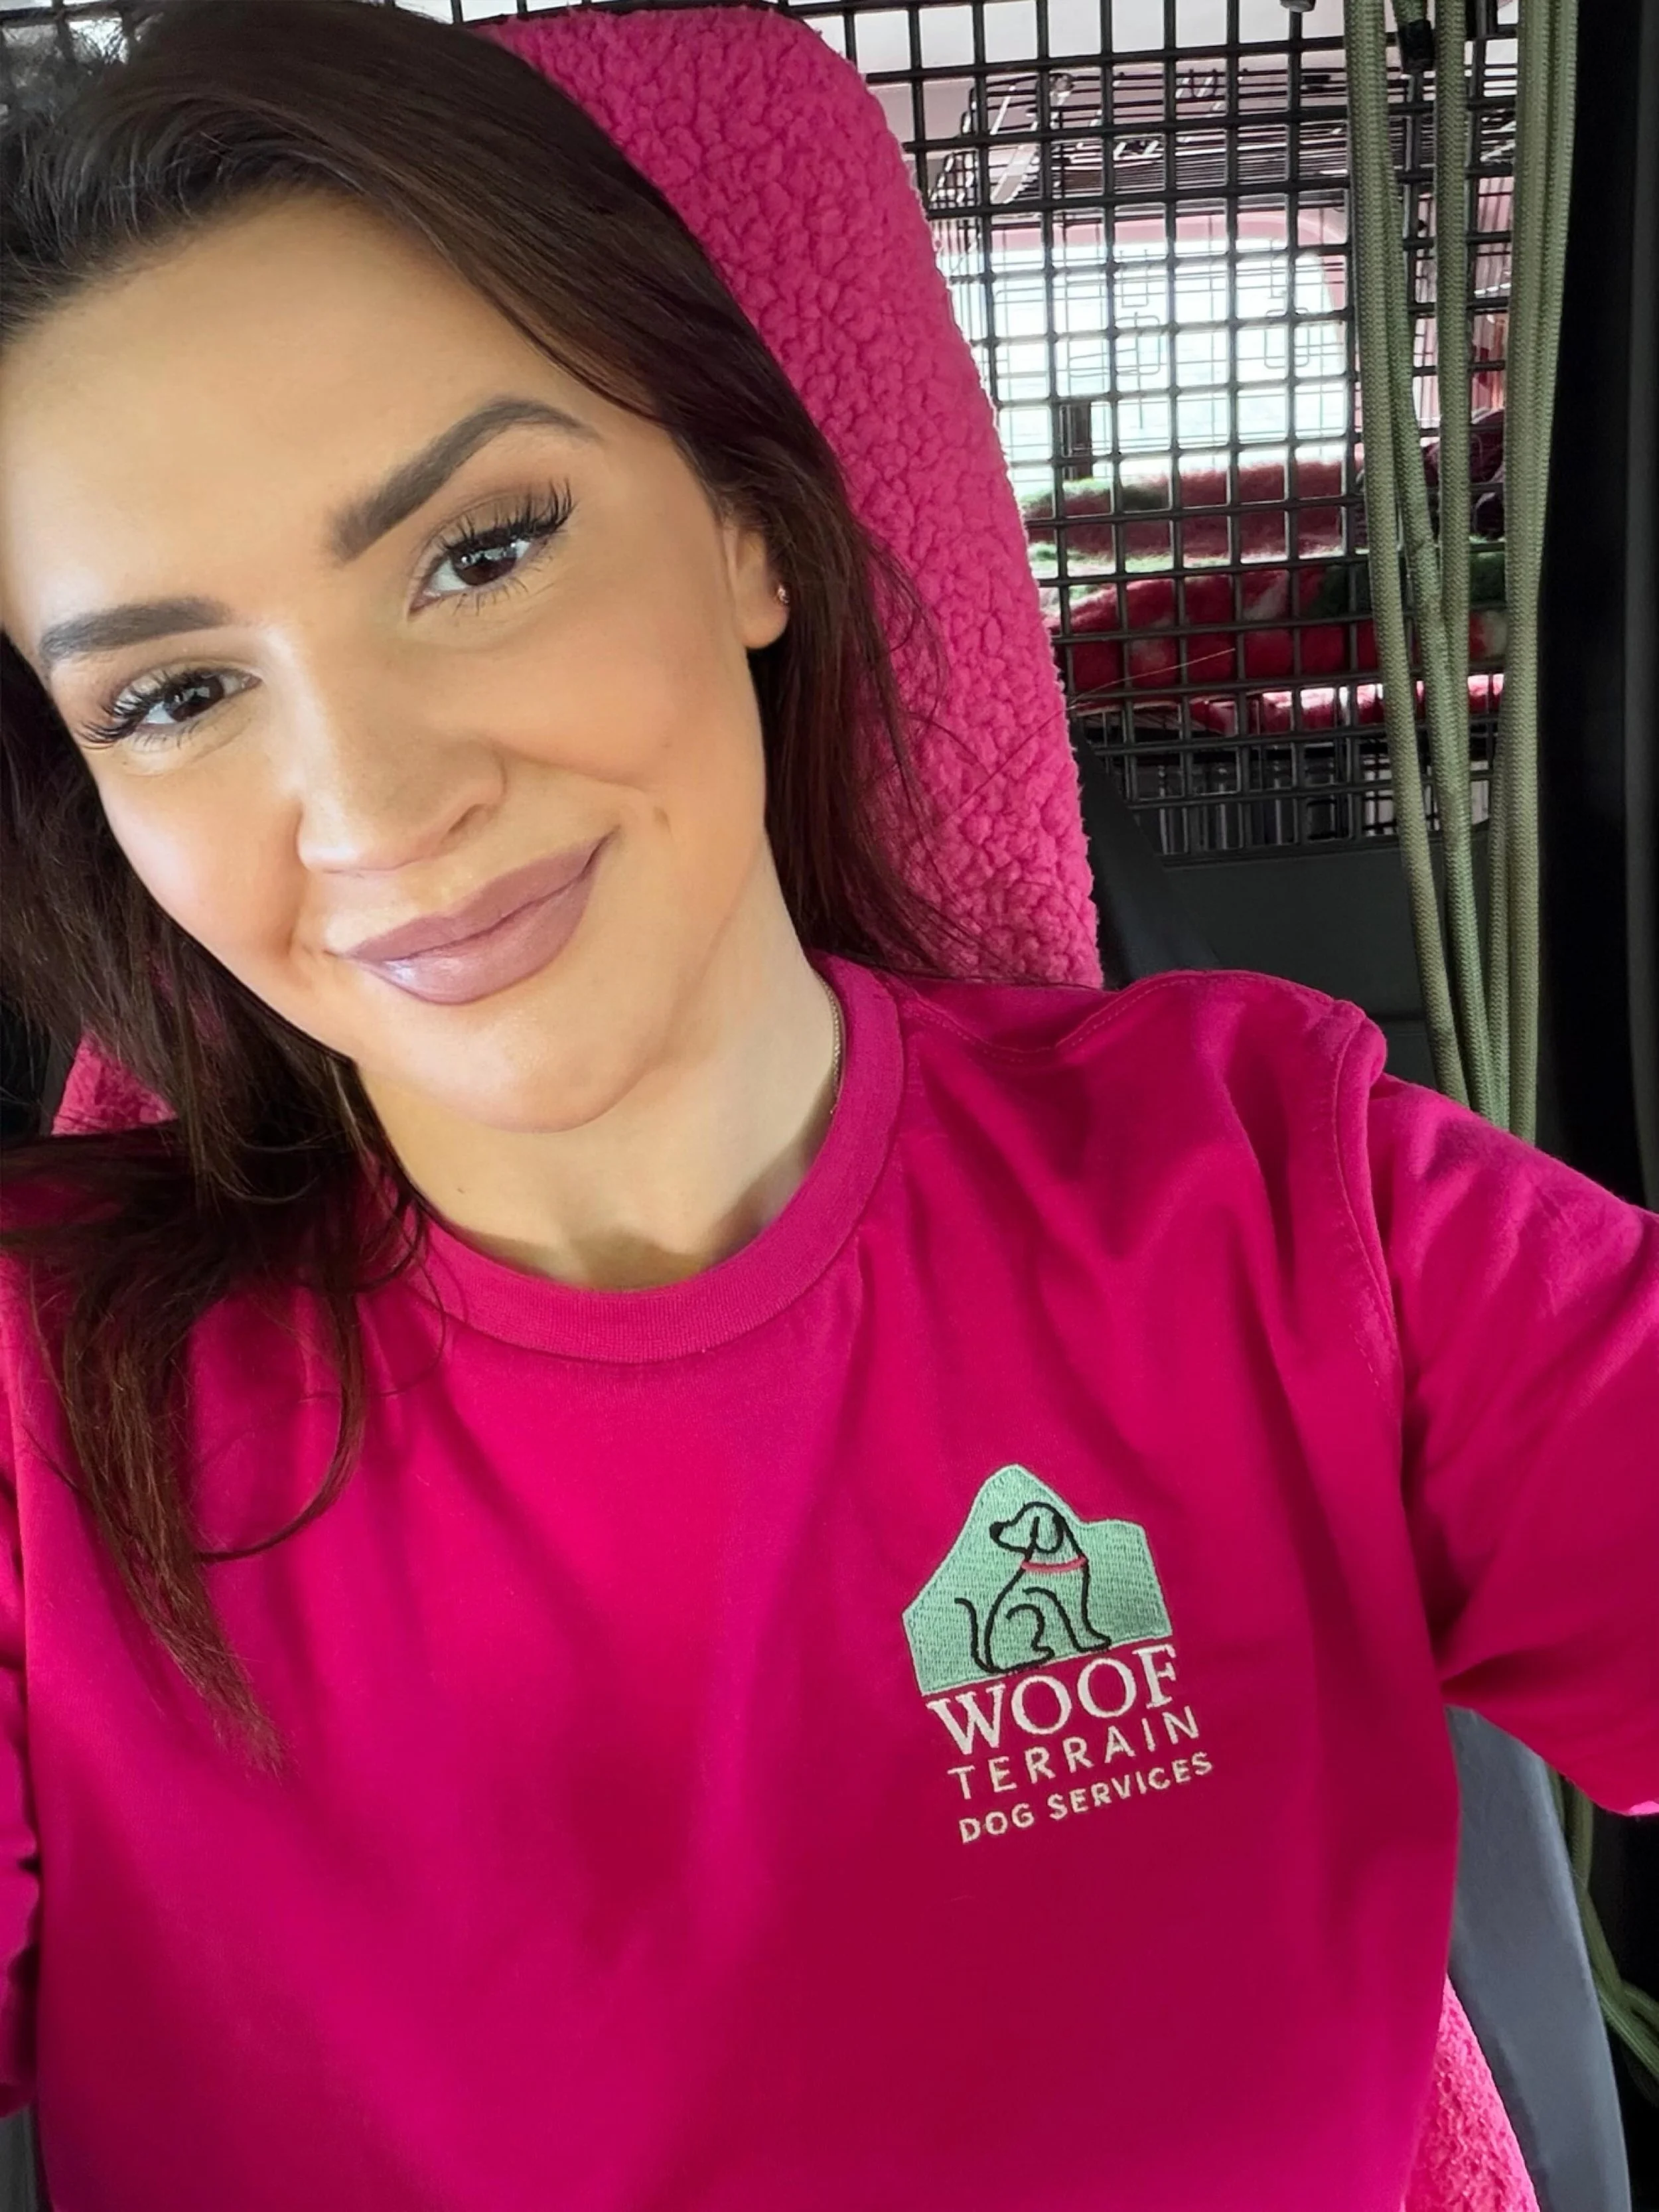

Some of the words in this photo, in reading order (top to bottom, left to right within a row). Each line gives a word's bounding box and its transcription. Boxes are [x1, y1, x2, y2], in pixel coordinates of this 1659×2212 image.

[926, 1644, 1177, 1755] WOOF
[948, 1706, 1200, 1800] TERRAIN
[958, 1803, 1035, 1844] DOG
[1047, 1751, 1213, 1820] SERVICES
